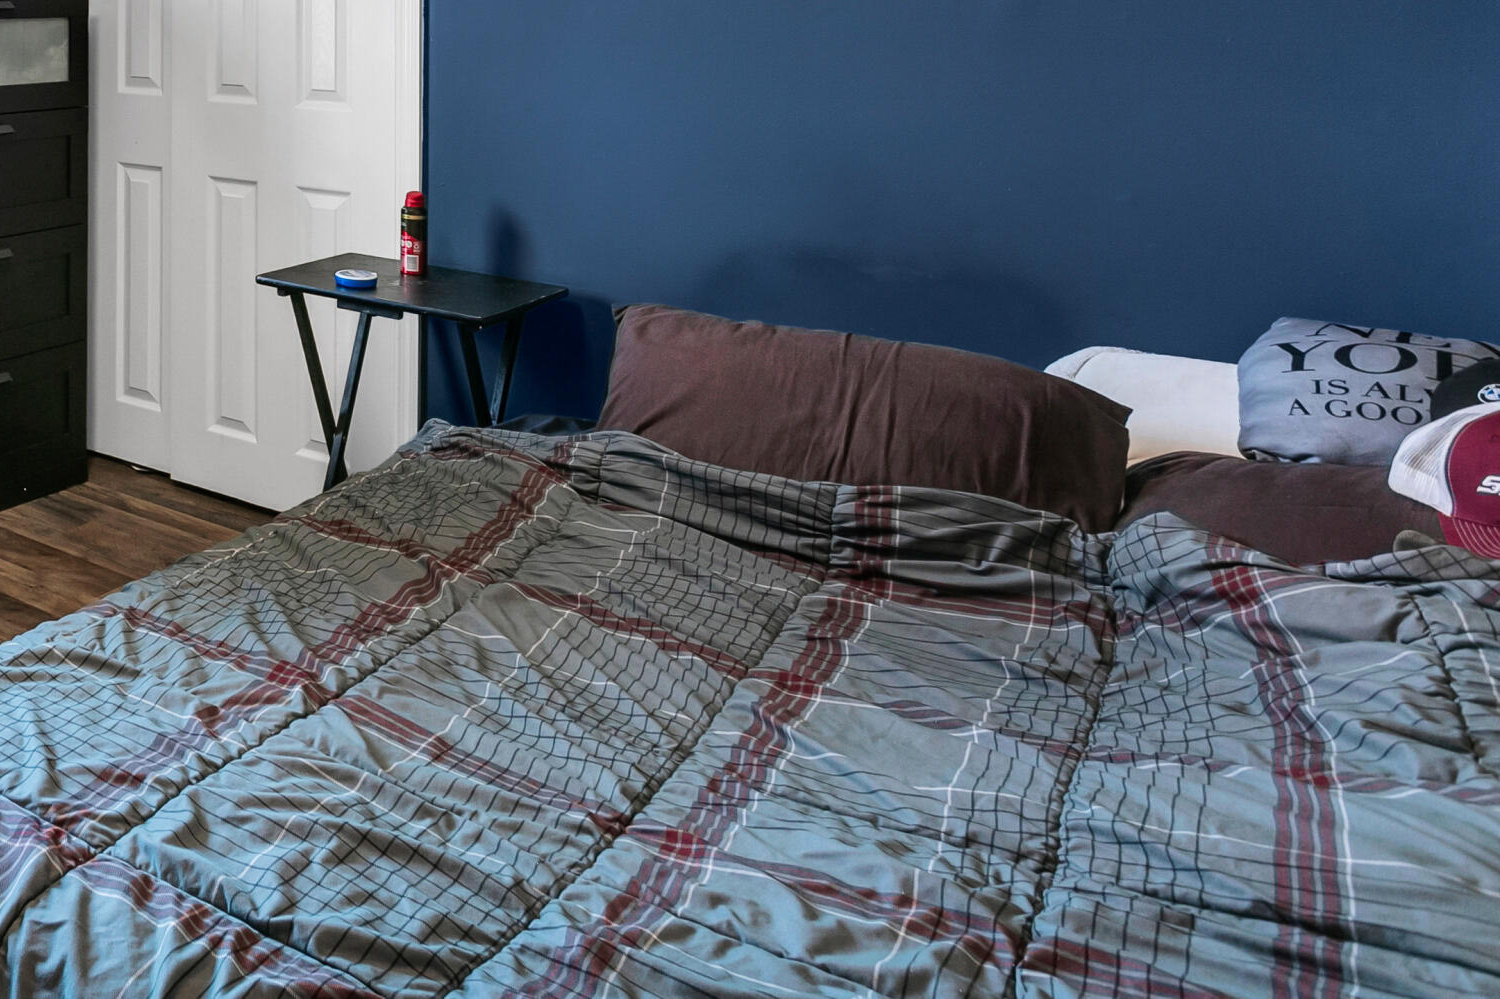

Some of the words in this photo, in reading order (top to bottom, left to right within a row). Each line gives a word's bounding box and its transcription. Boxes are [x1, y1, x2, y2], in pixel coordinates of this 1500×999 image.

[1311, 379, 1350, 395] IS
[1288, 398, 1311, 416] A
[1324, 399, 1430, 425] GOO
